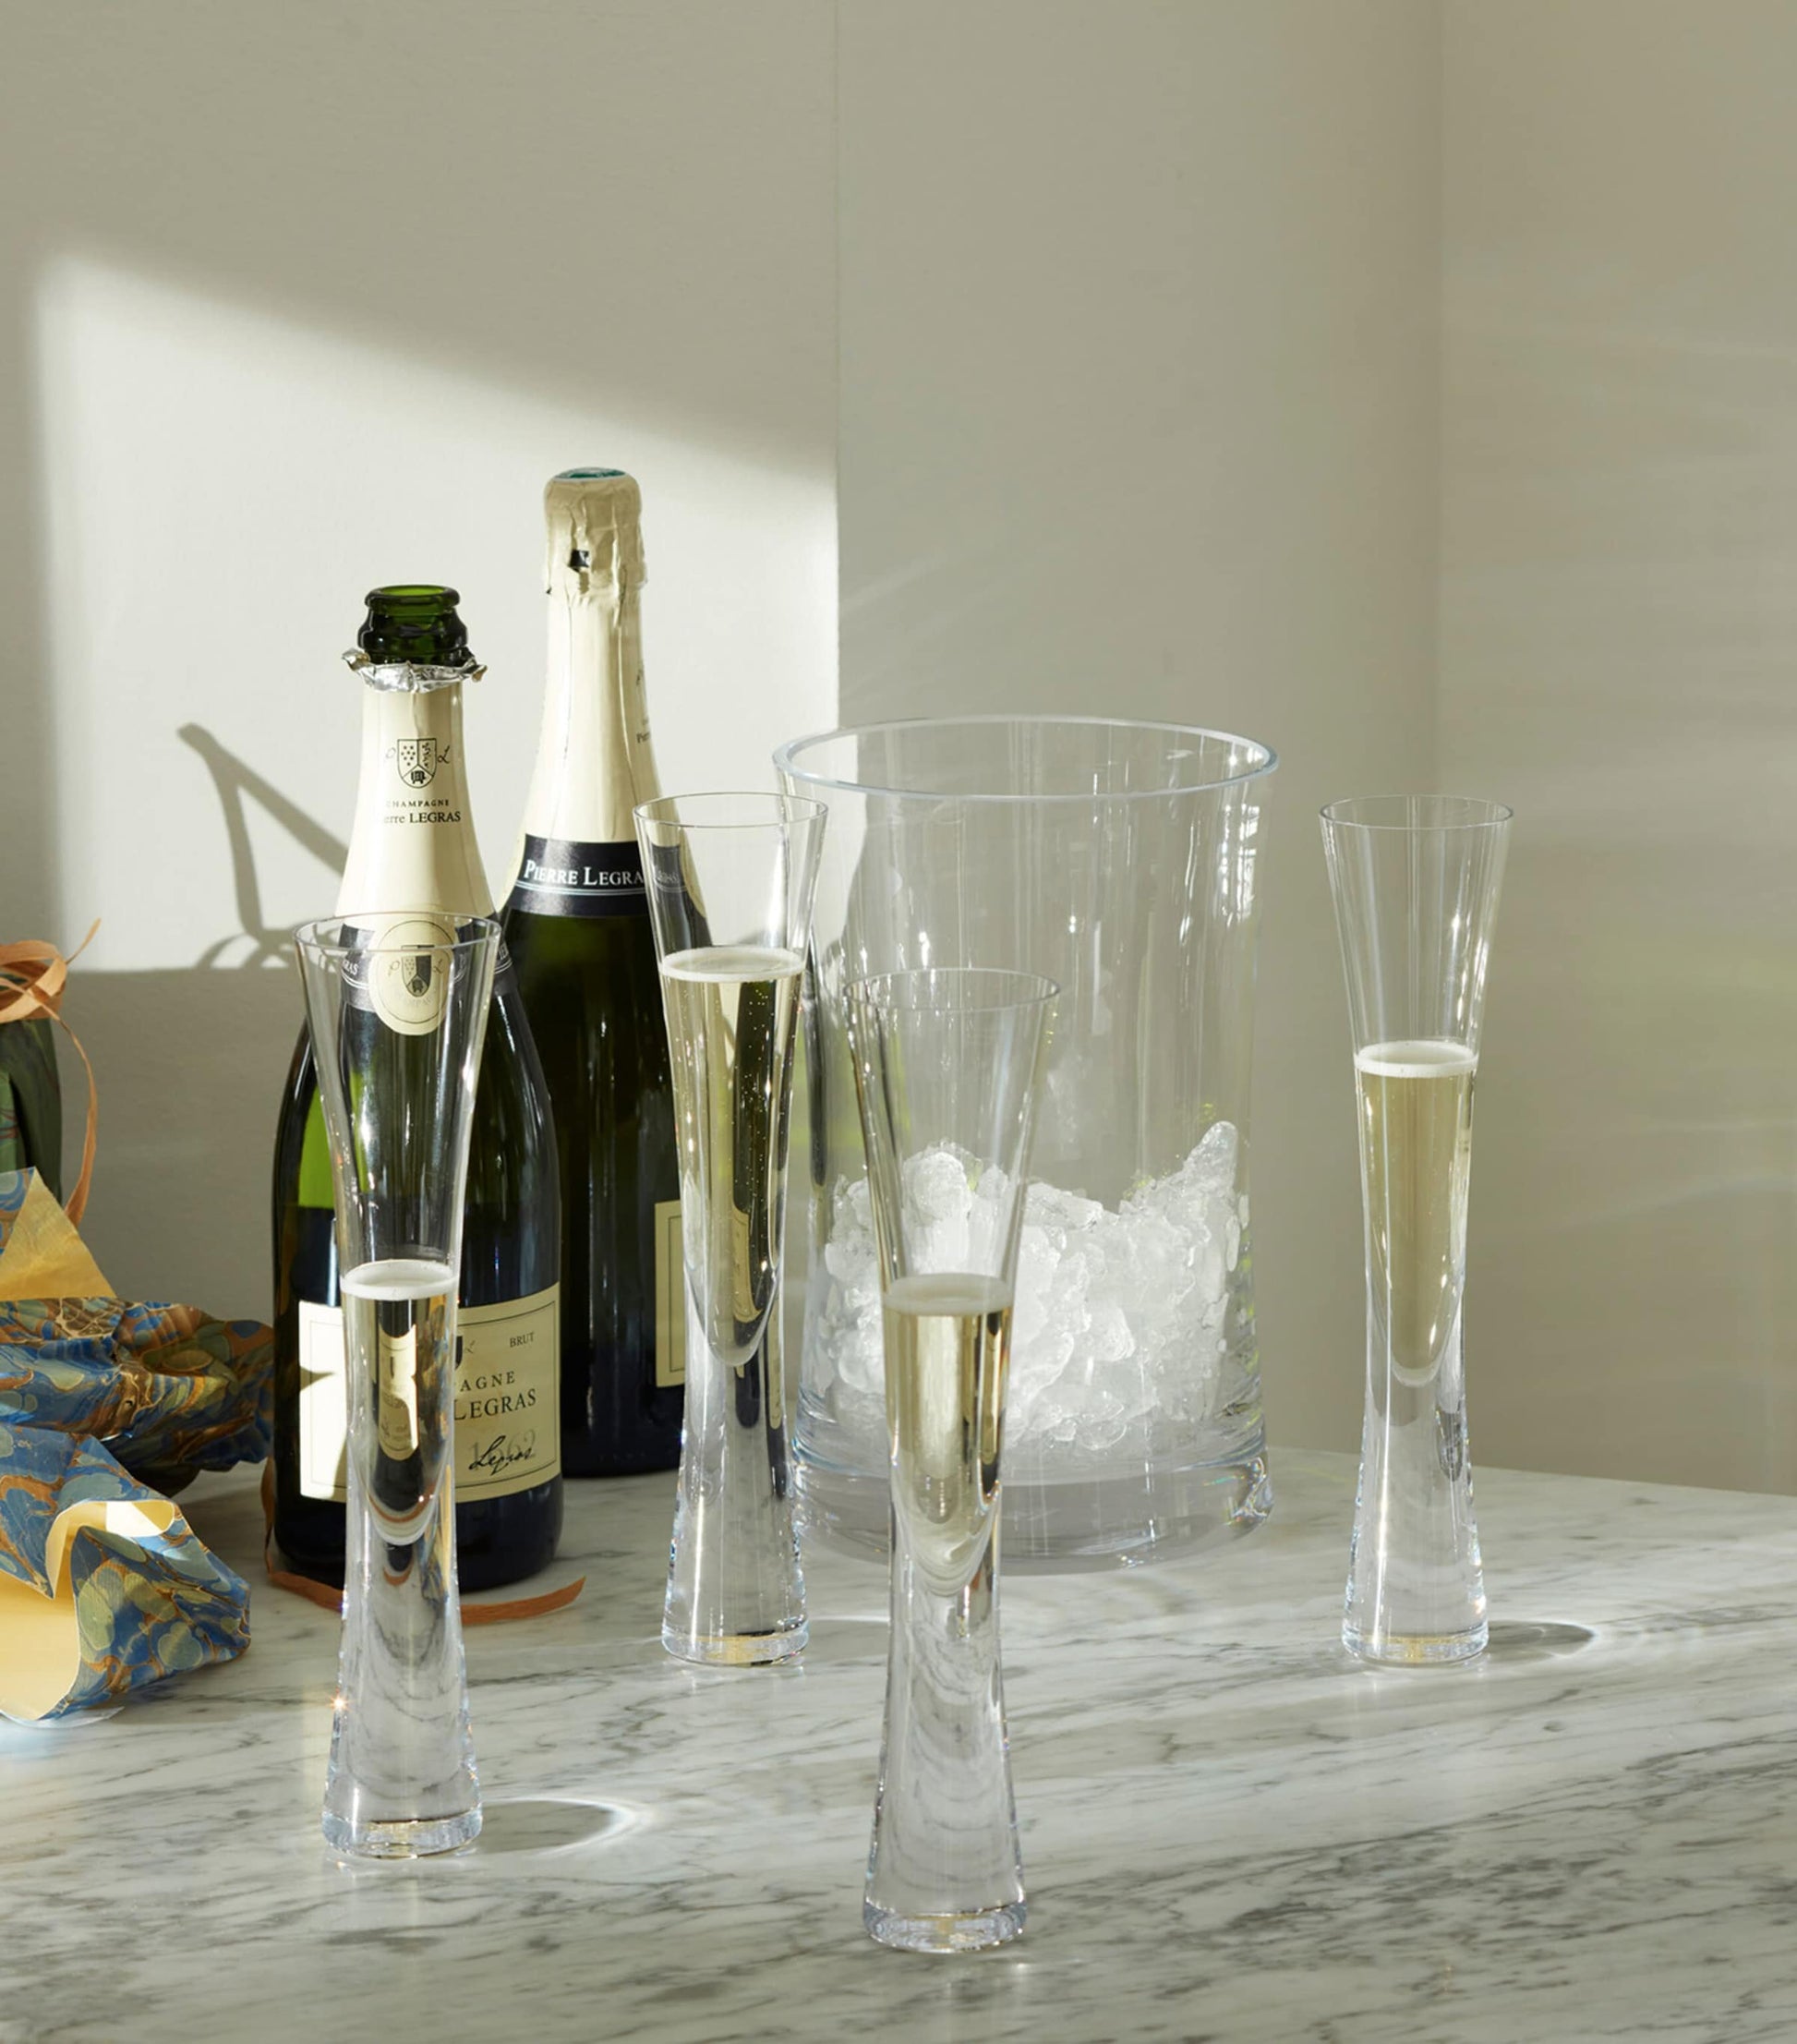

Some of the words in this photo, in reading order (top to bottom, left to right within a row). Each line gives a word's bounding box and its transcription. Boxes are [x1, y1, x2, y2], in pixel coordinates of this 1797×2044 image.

[409, 811, 462, 824] LEGRAS
[523, 858, 579, 886] PIERRE
[583, 866, 645, 887] LEGRA
[509, 1331, 536, 1349] BRUT
[453, 1388, 537, 1421] LEGRAS
